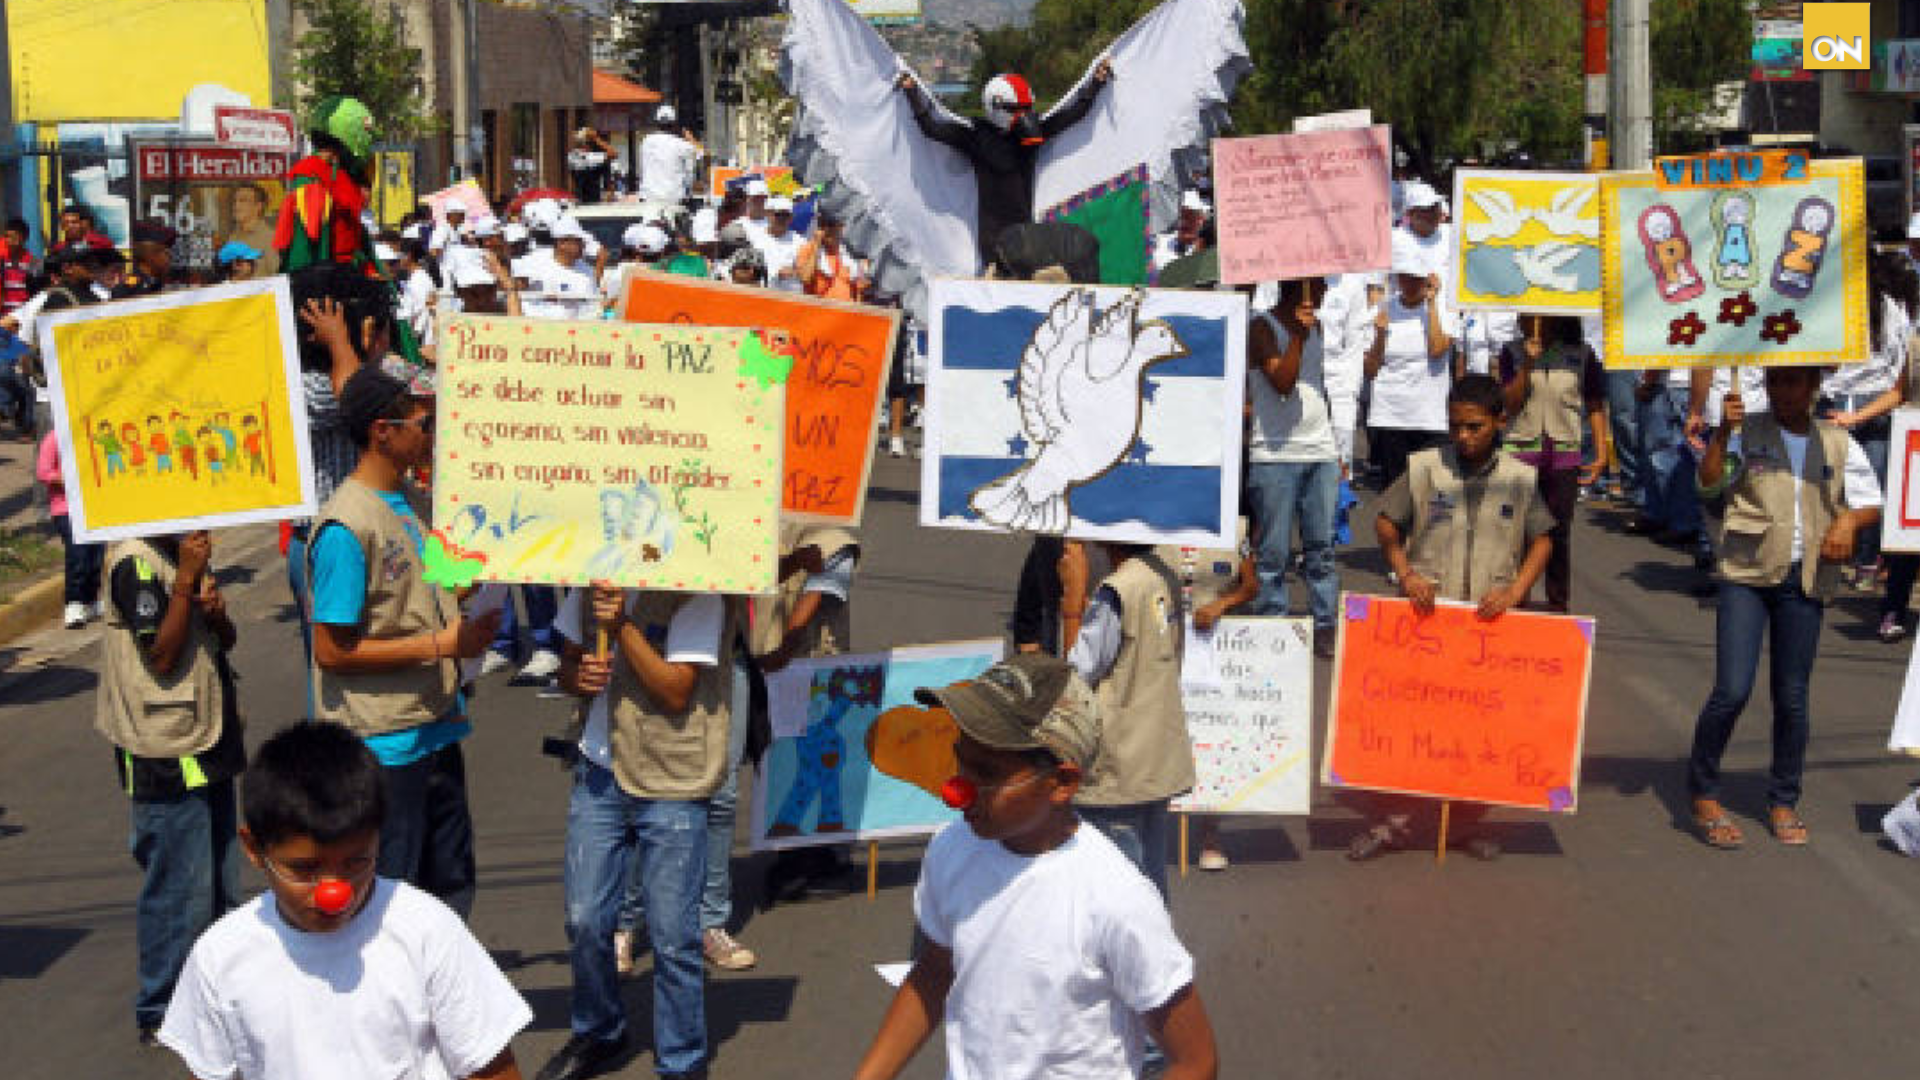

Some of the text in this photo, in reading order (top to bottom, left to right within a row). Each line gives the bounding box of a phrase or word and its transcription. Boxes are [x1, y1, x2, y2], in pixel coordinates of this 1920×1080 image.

[146, 150, 284, 175] El Heraldo
[1782, 154, 1808, 179] 2
[457, 323, 715, 374] Para construir la PAZ
[457, 376, 676, 412] se debe actuar sin
[574, 425, 609, 445] sin
[792, 414, 840, 447] UN
[471, 461, 505, 481] sin
[602, 466, 637, 484] sin
[785, 469, 848, 510] PAZ
